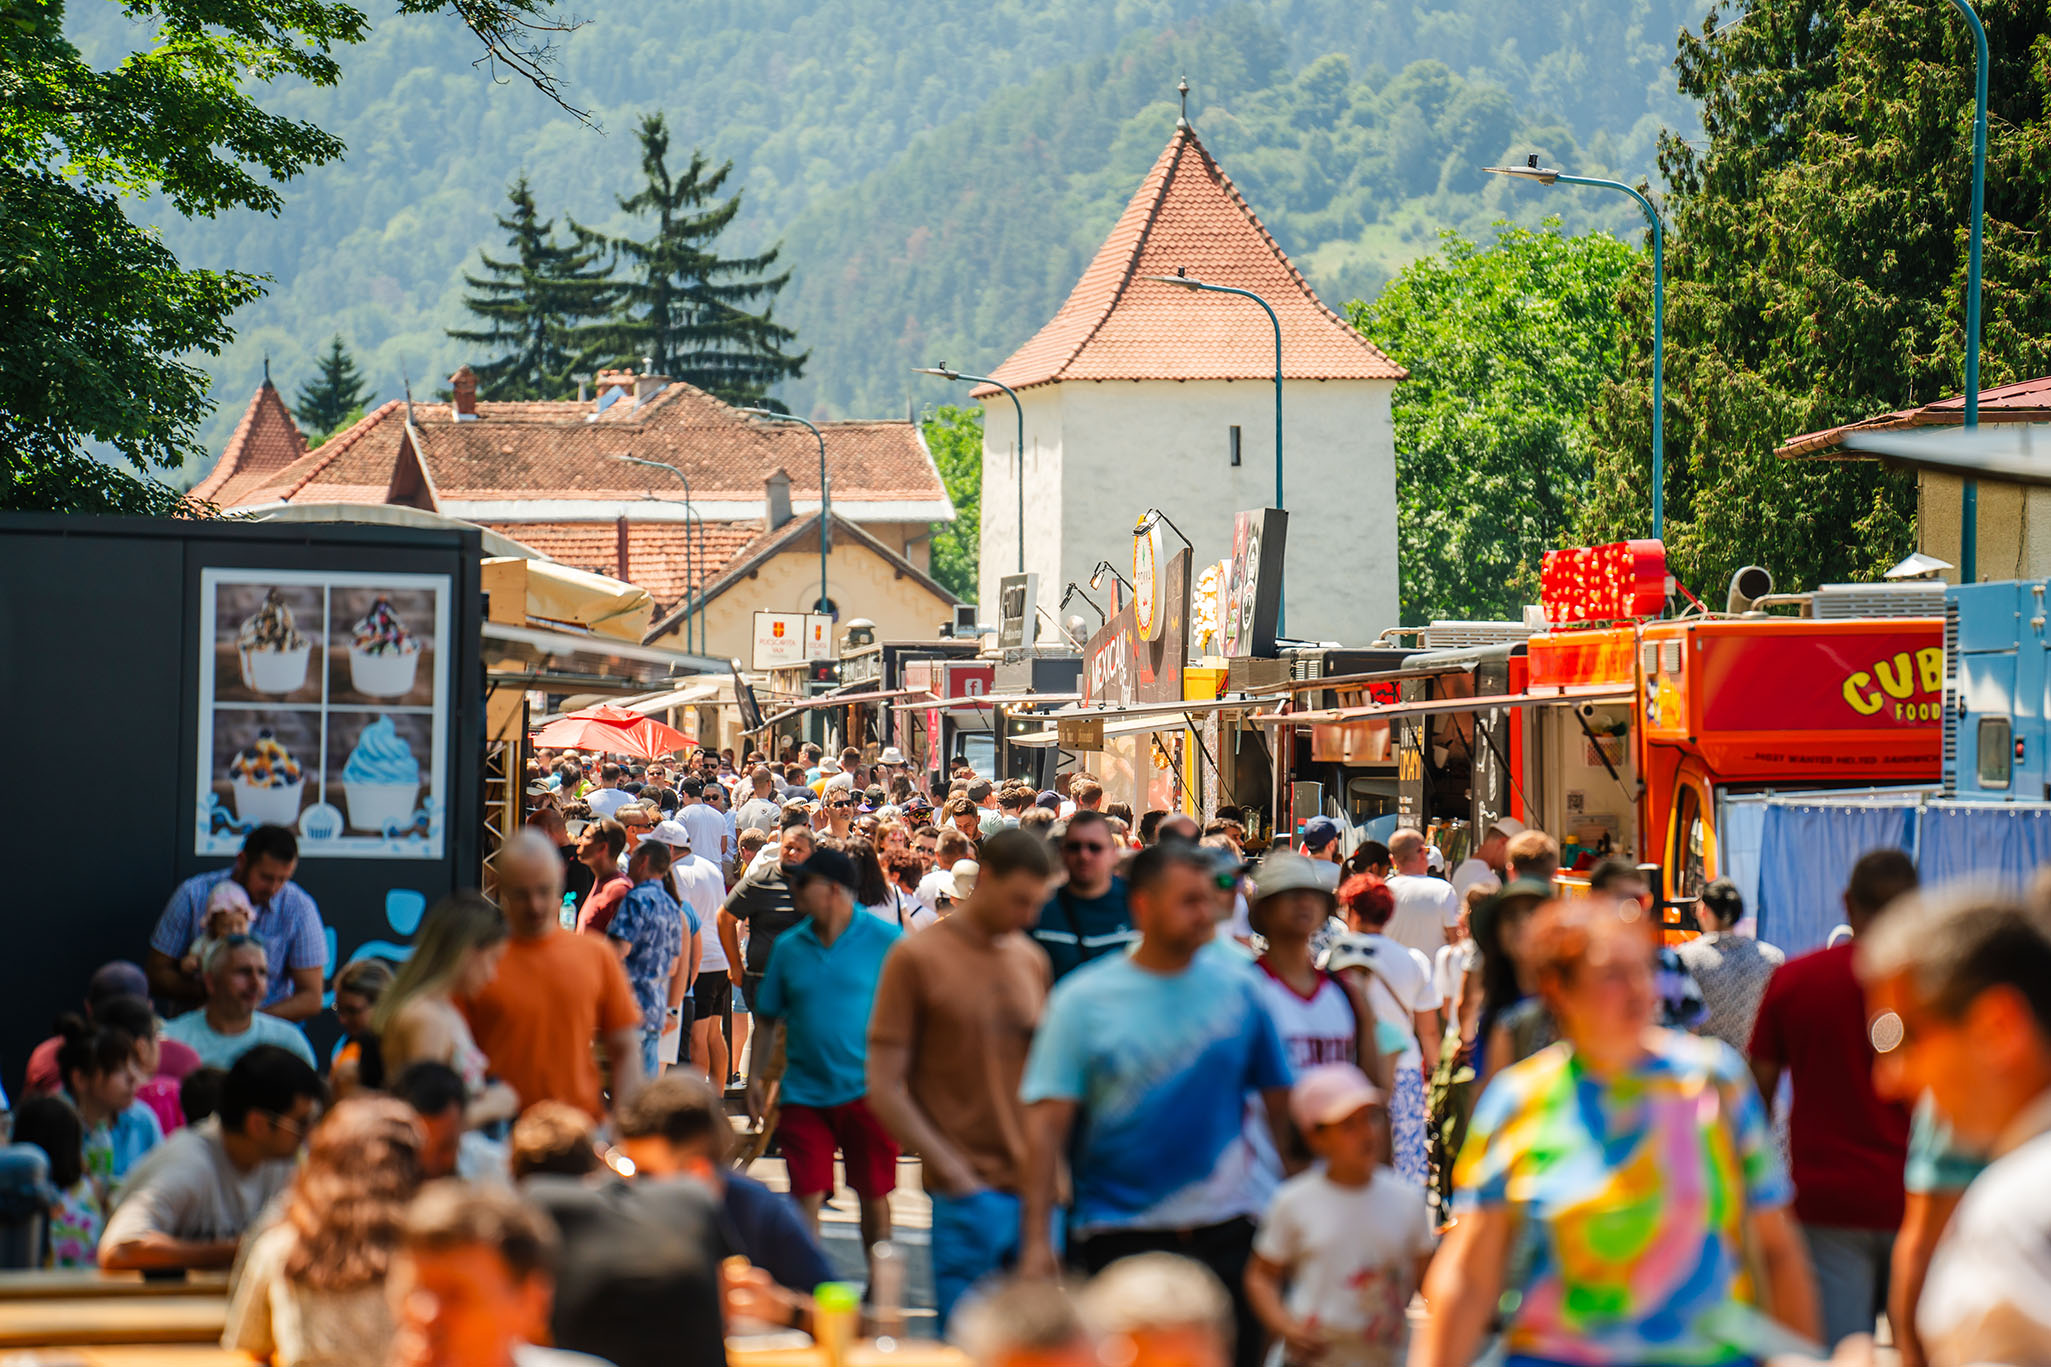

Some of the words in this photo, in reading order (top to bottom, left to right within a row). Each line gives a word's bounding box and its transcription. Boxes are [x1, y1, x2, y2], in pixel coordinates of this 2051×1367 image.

[1091, 624, 1127, 697] MEXICAN
[1843, 647, 1943, 716] CUB
[1895, 702, 1941, 721] FOOD
